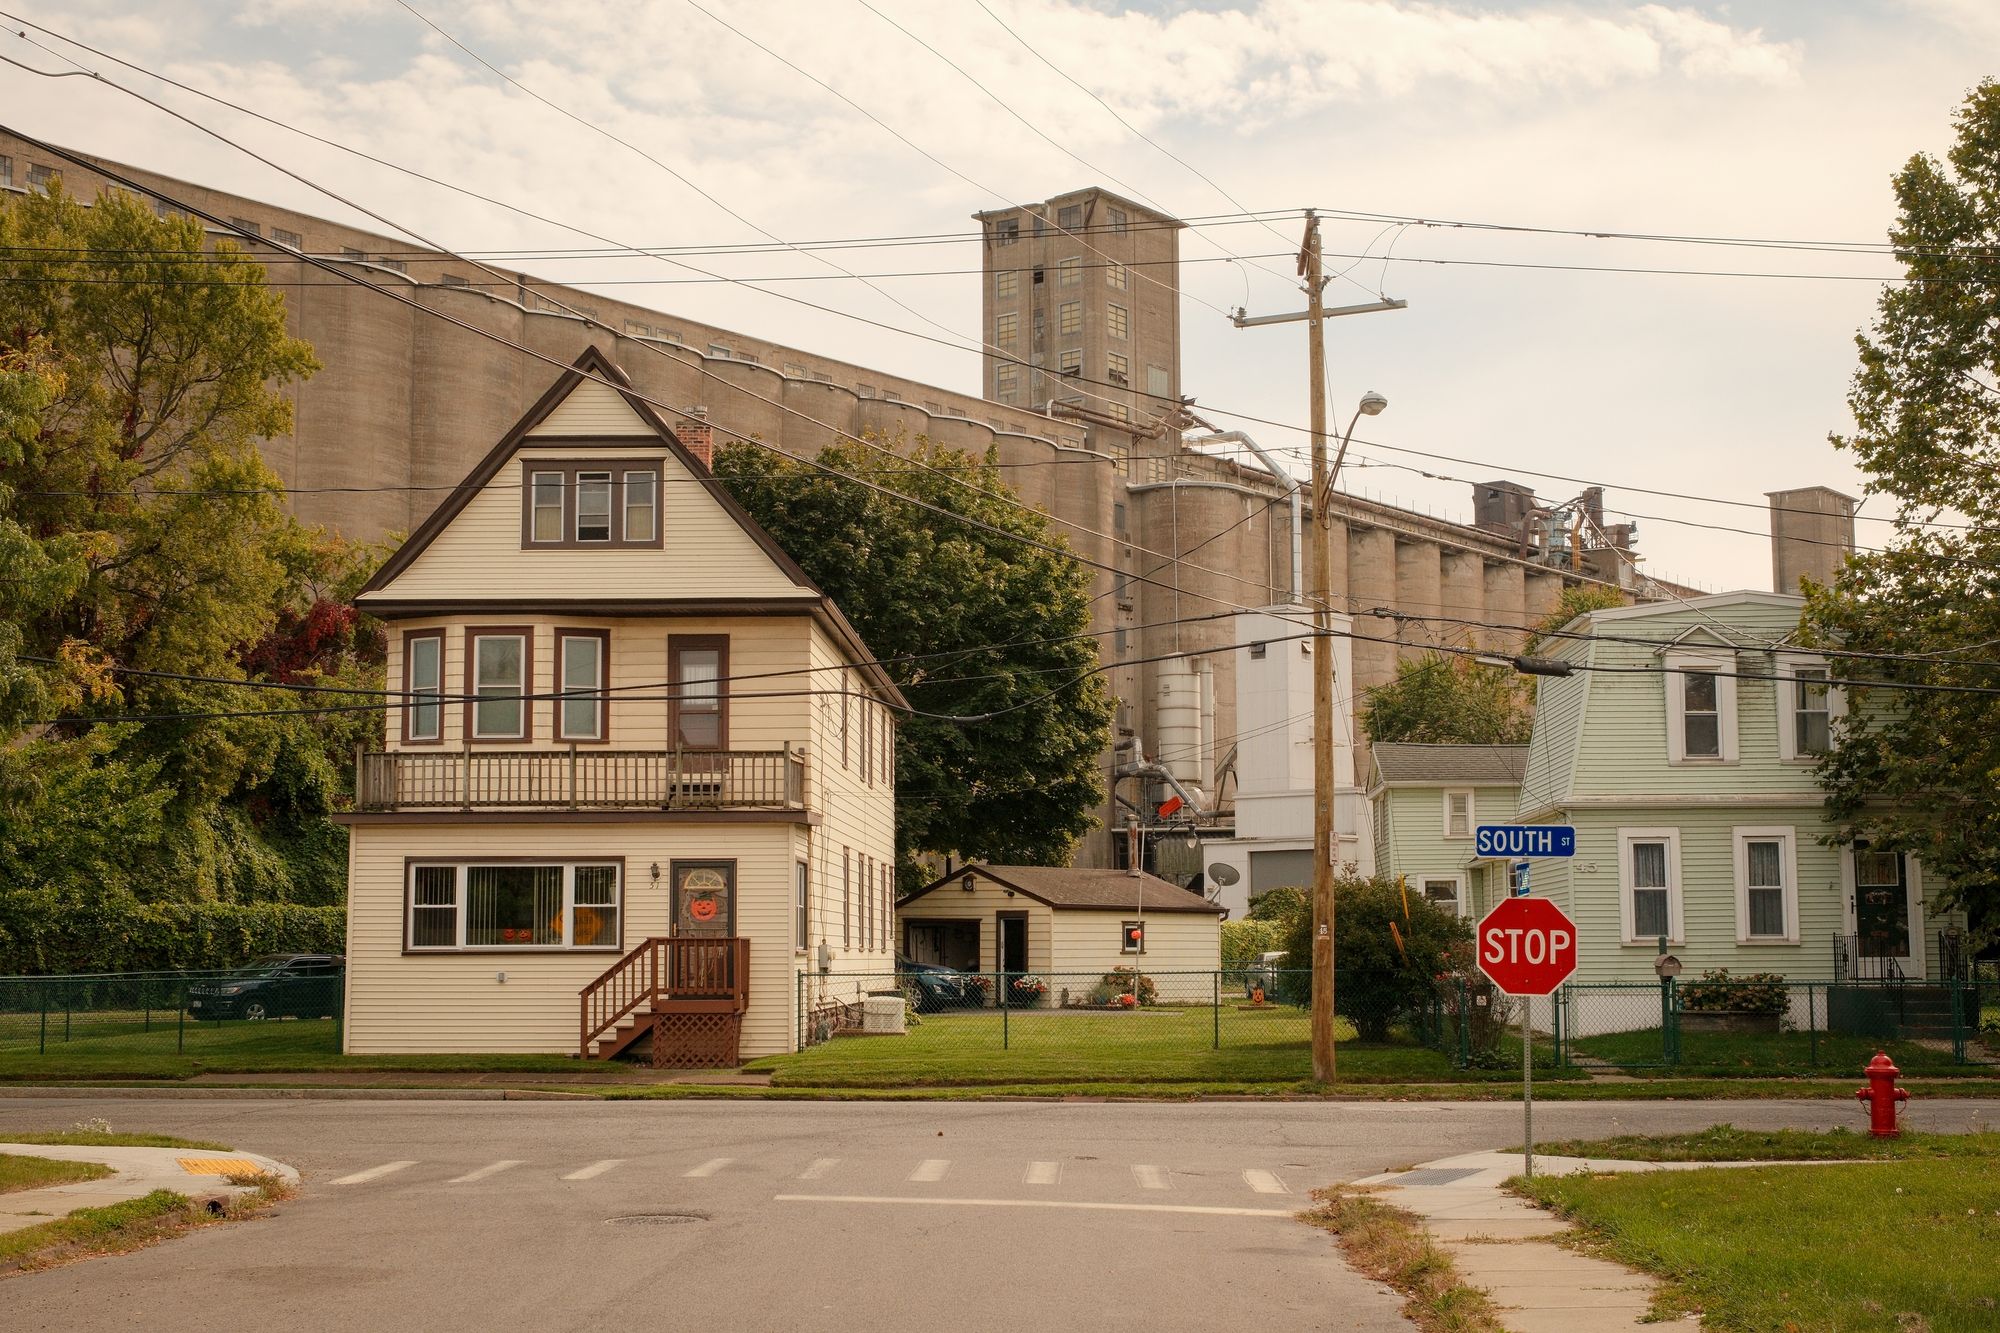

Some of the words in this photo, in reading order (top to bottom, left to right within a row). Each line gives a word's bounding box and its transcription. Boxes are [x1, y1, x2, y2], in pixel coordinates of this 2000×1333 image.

[1478, 830, 1552, 852] SOUTH
[1561, 837, 1571, 846] ST
[1575, 861, 1598, 873] 45
[1484, 928, 1571, 965] STOP
